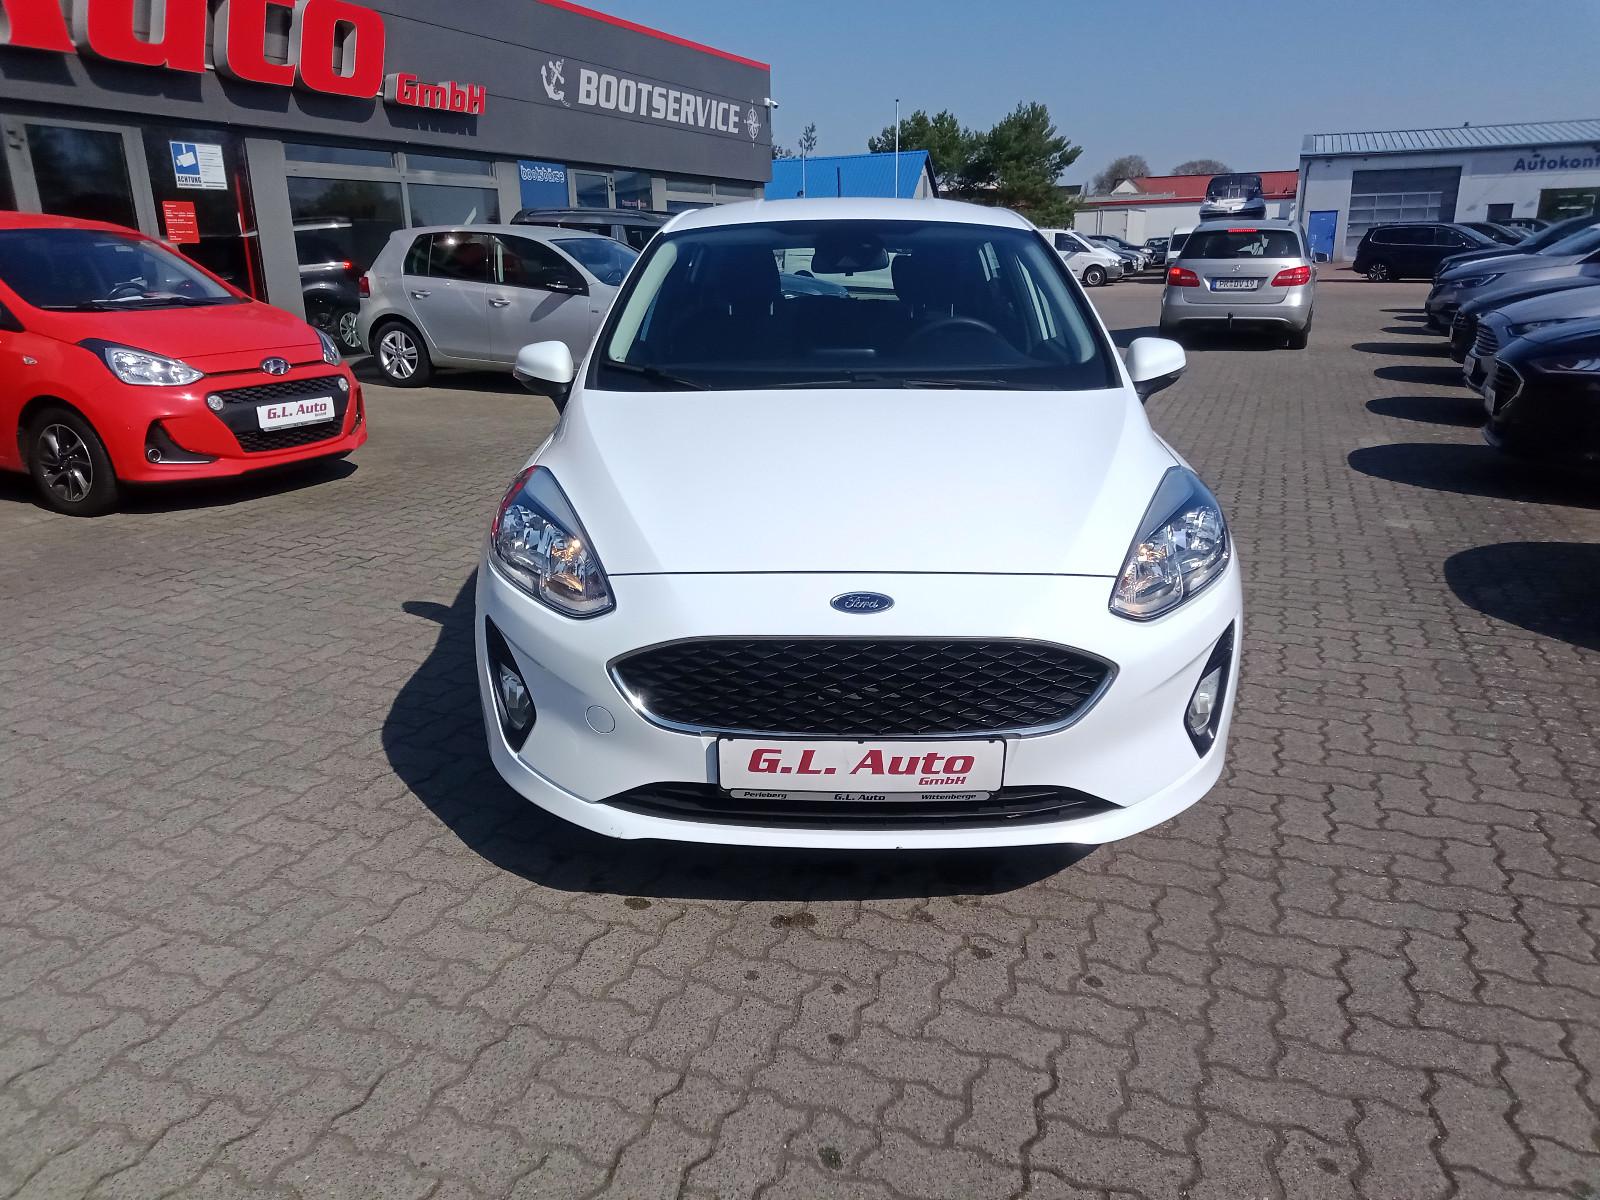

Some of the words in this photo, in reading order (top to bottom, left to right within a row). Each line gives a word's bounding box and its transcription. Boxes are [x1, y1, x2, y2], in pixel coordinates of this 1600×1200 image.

[396, 72, 486, 115] GmbH
[578, 68, 741, 134] BOOTSERVICE
[267, 407, 293, 420] G.L.
[296, 402, 327, 416] Auto
[844, 596, 879, 608] Ford
[747, 748, 837, 775] G.L.
[849, 749, 975, 776] Auto
[918, 776, 967, 786] GmbH
[834, 793, 856, 801] G.L.
